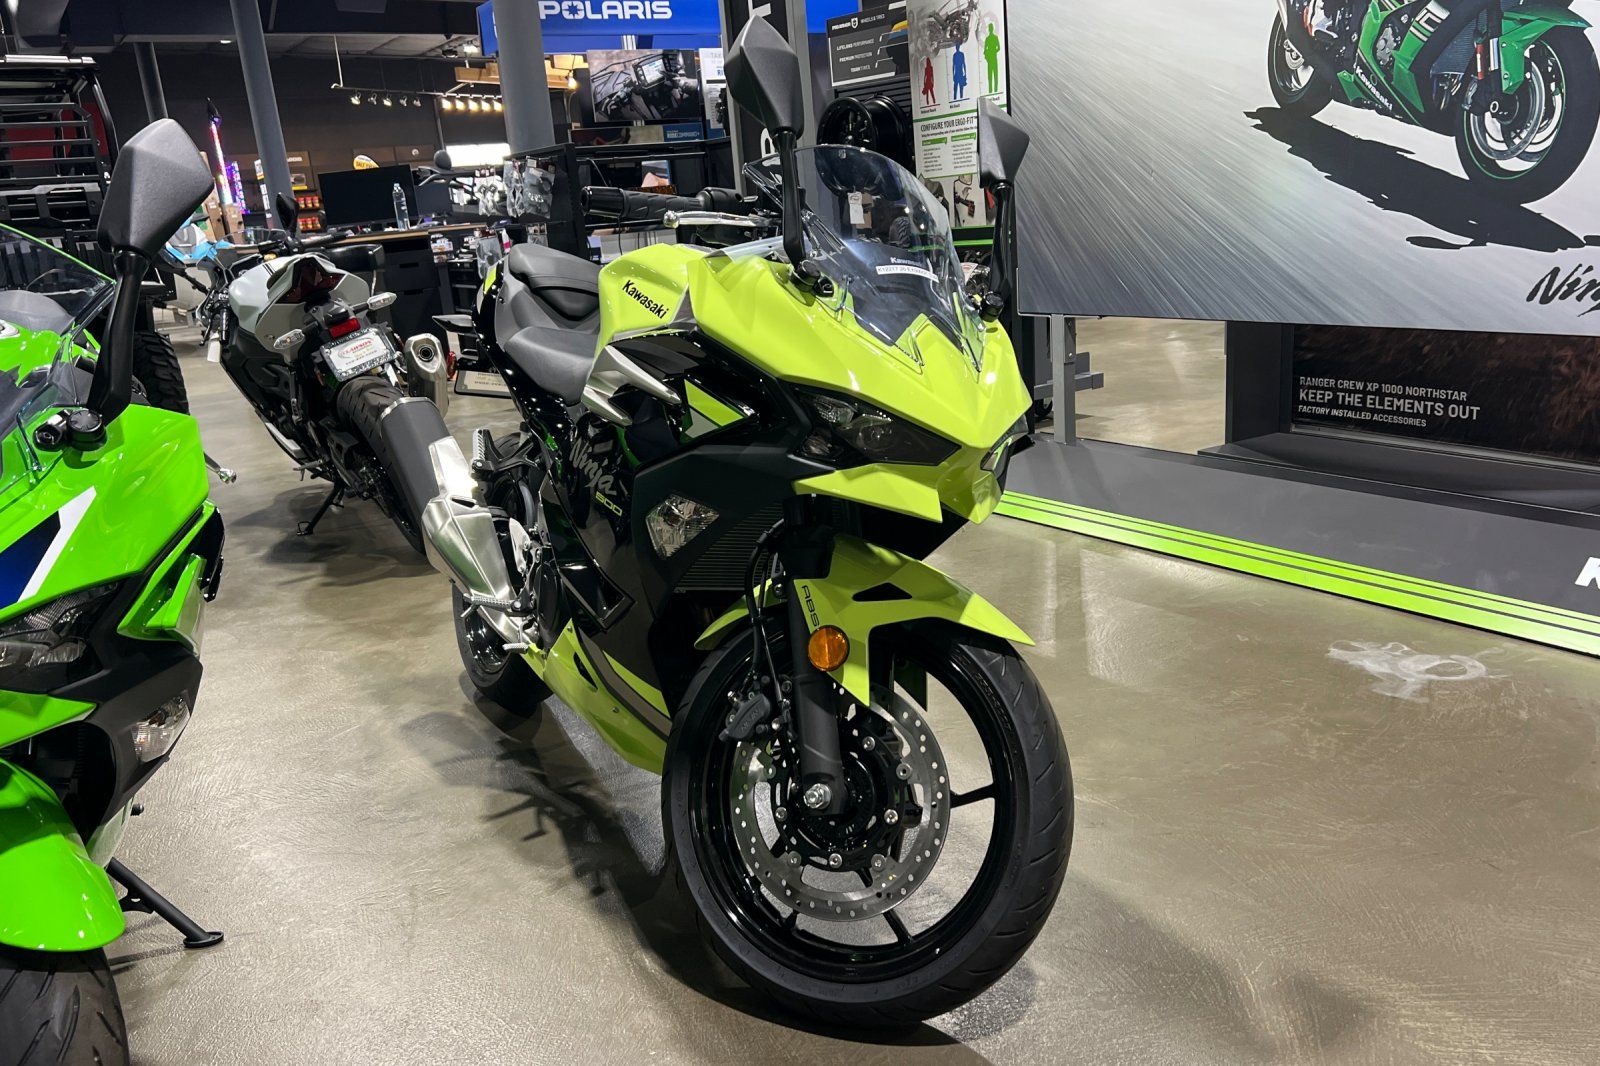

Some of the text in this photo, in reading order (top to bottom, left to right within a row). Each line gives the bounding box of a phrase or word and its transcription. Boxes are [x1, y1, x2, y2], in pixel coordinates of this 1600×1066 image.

[539, 1, 672, 20] POLARIS
[1356, 66, 1393, 111] Kawasaki
[921, 121, 943, 132] CONFIGURE
[944, 119, 955, 128] YOUR
[622, 280, 669, 319] Kawasaki
[1526, 263, 1600, 317] Nin
[1299, 389, 1480, 420] KEEP THE ELEMENTS OUT
[1300, 376, 1467, 402] RANGER CREW XP 1000 NORTHSTAR
[1298, 405, 1427, 427] FACTORY INSTALLED ACCESSORIES
[569, 436, 617, 496] Ninja
[801, 585, 820, 627] ABS
